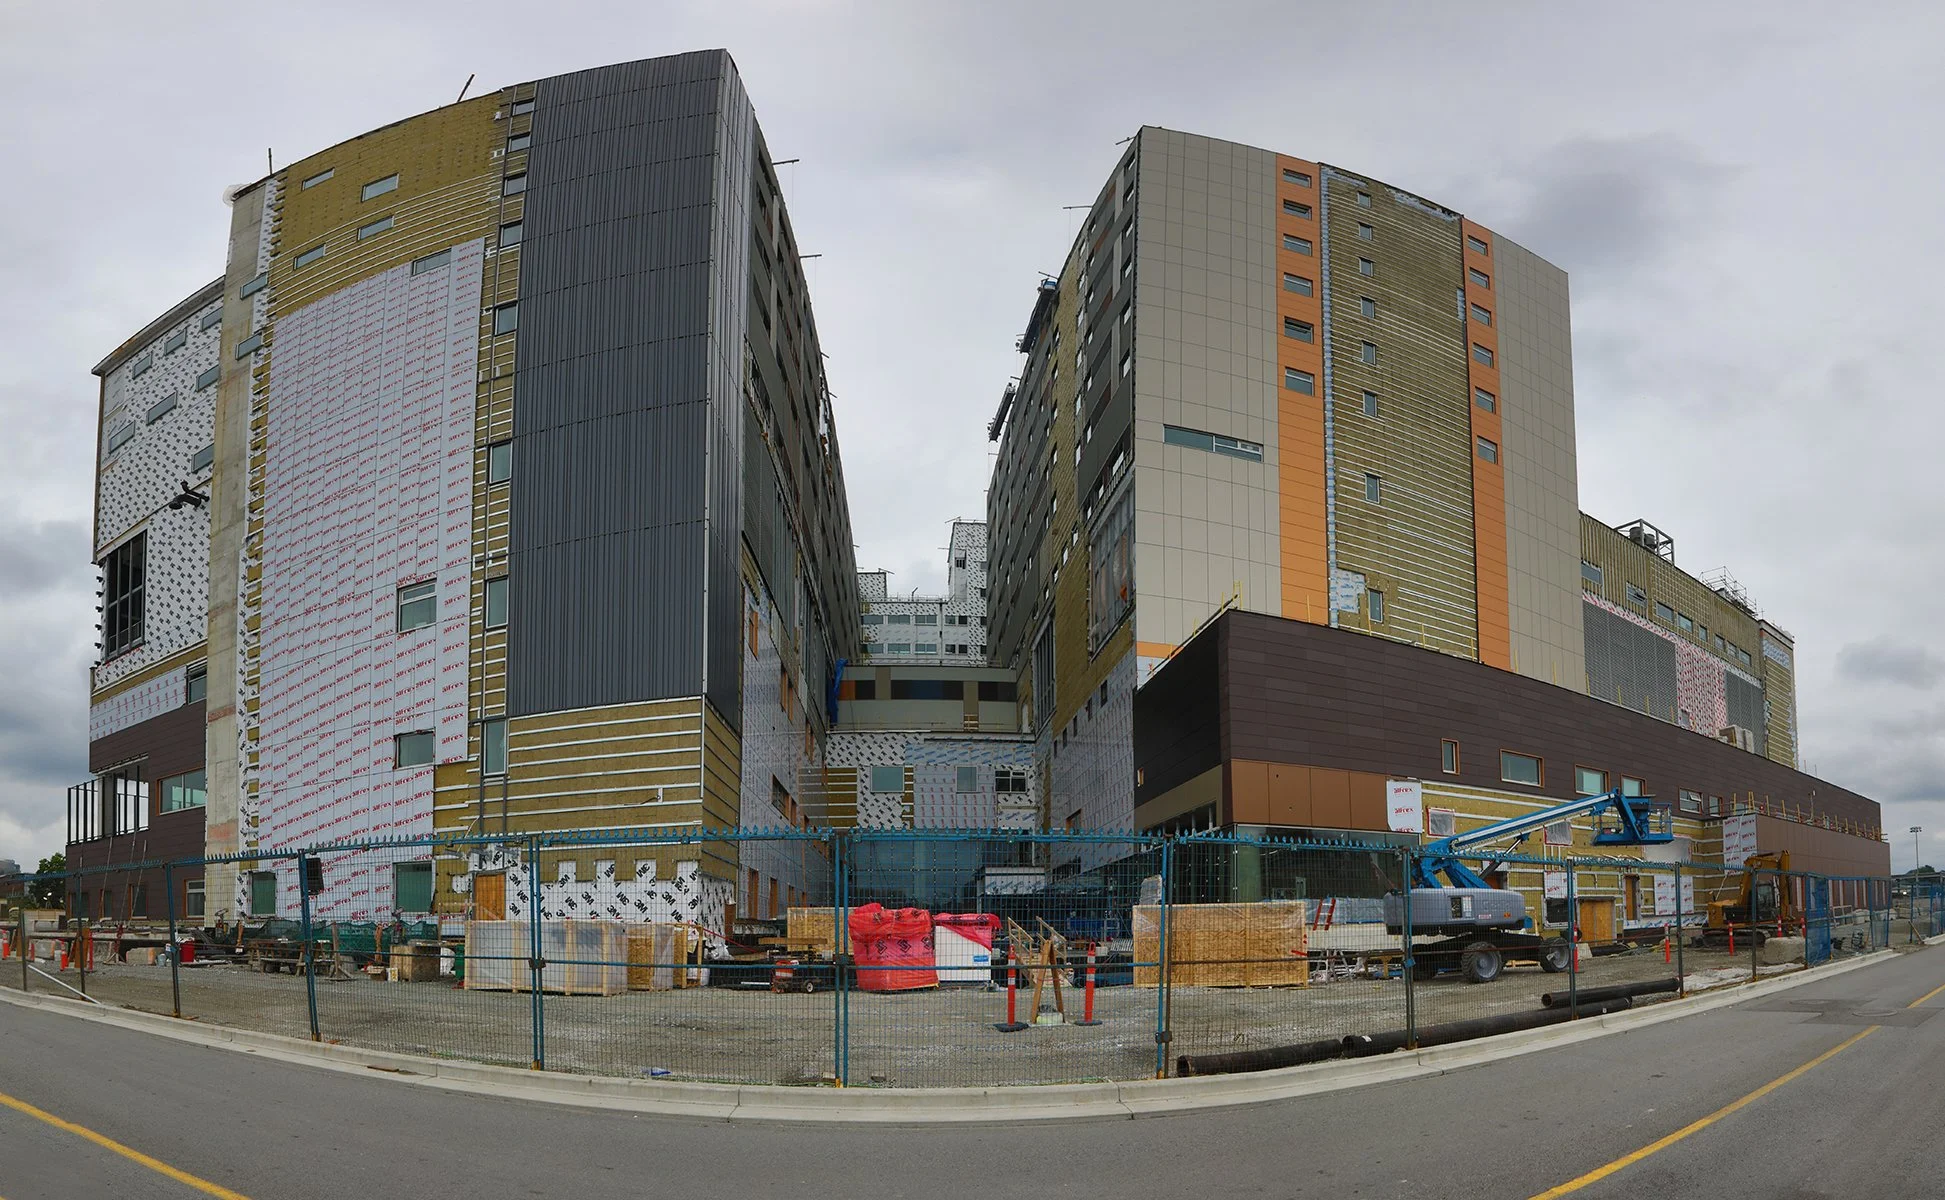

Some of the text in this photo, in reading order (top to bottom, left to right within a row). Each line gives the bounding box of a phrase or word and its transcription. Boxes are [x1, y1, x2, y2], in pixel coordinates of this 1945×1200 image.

[636, 863, 650, 878] 3M
[509, 873, 521, 887] 3M
[581, 891, 594, 905] 3M
[616, 892, 629, 906] 3M
[661, 891, 677, 906] 3M
[509, 903, 521, 916] 3M
[634, 899, 649, 914] 3M
